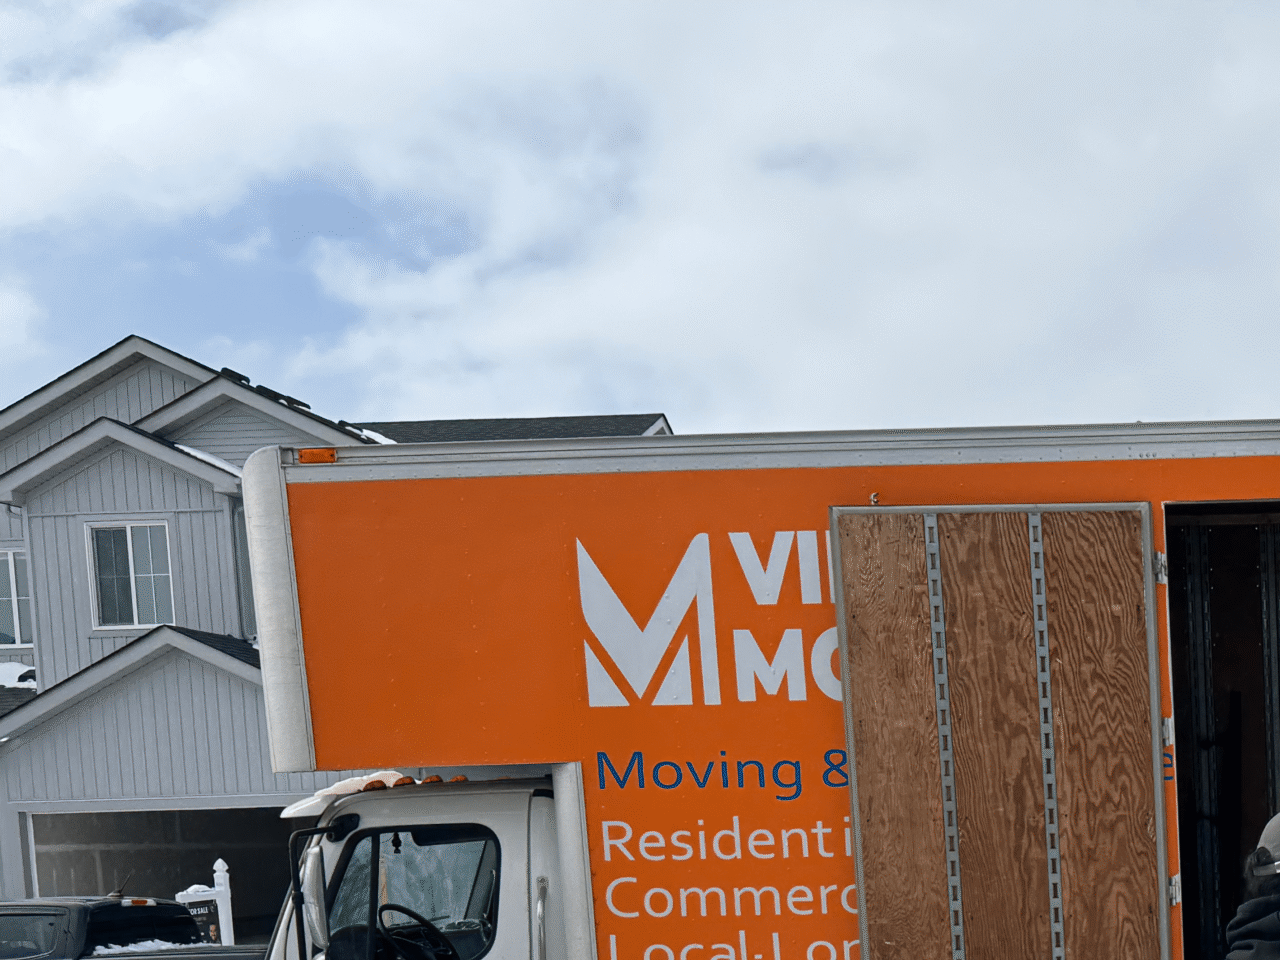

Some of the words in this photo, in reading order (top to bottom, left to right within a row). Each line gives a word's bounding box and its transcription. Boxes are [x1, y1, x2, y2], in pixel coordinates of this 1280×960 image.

[728, 530, 836, 605] VI
[596, 751, 802, 801] Moving
[822, 749, 849, 788] &
[601, 816, 852, 861] Residenti
[605, 876, 858, 918] Commerc
